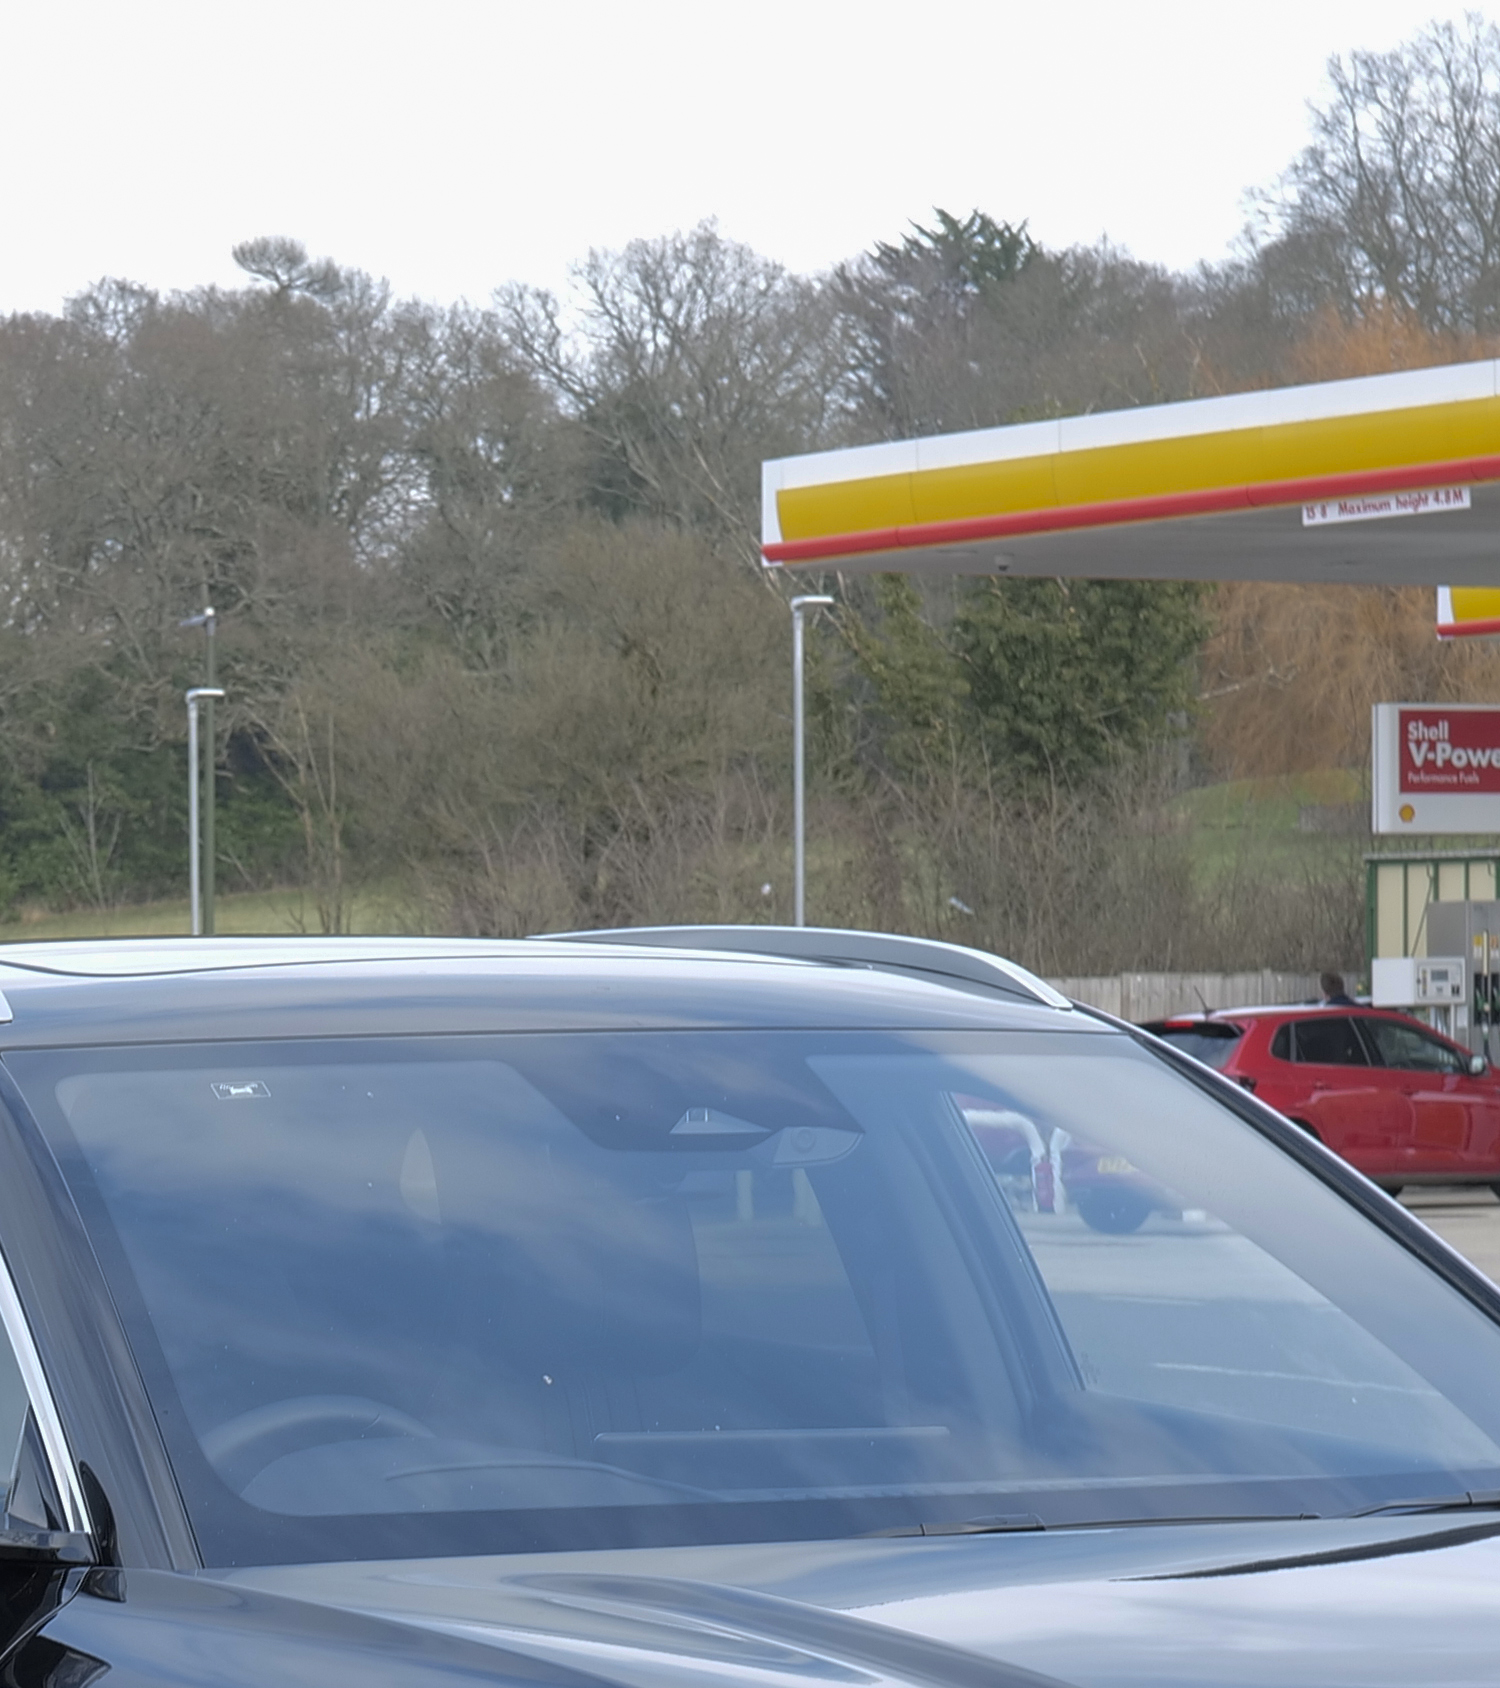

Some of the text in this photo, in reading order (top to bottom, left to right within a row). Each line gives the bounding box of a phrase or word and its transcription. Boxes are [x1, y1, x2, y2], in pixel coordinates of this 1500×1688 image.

[1337, 499, 1391, 517] Maximum
[1395, 491, 1429, 512] height
[1407, 719, 1450, 741] Shell
[1407, 770, 1480, 785] Performance Fuels
